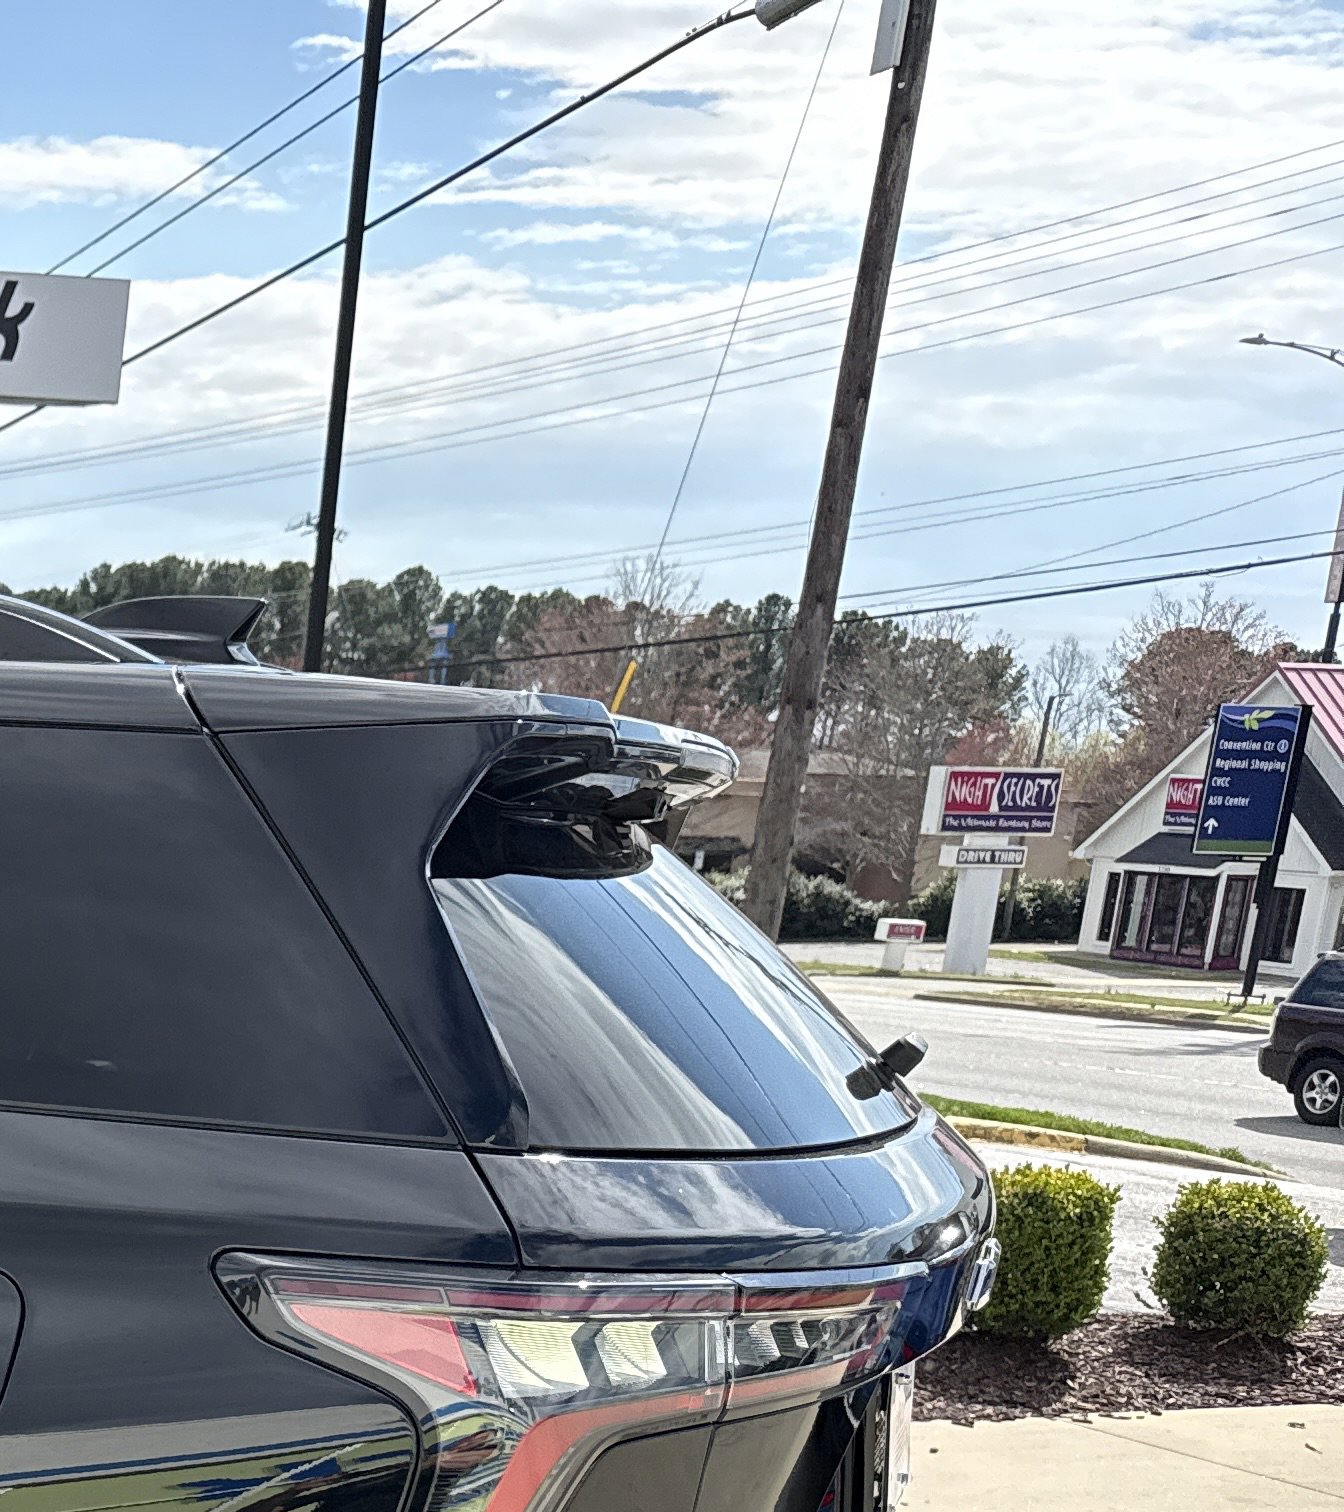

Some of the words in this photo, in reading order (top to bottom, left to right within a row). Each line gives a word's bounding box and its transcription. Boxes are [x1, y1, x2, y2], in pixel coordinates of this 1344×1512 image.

[1219, 739, 1261, 751] Convention
[1263, 741, 1275, 751] Ctr
[1215, 758, 1248, 770] Regional
[1250, 759, 1286, 773] Shopping
[1211, 776, 1231, 787] CVCC
[1001, 777, 1060, 807] SECRETS
[1224, 796, 1250, 807] Center
[958, 850, 991, 863] DRIVE
[993, 851, 1023, 863] THRU
